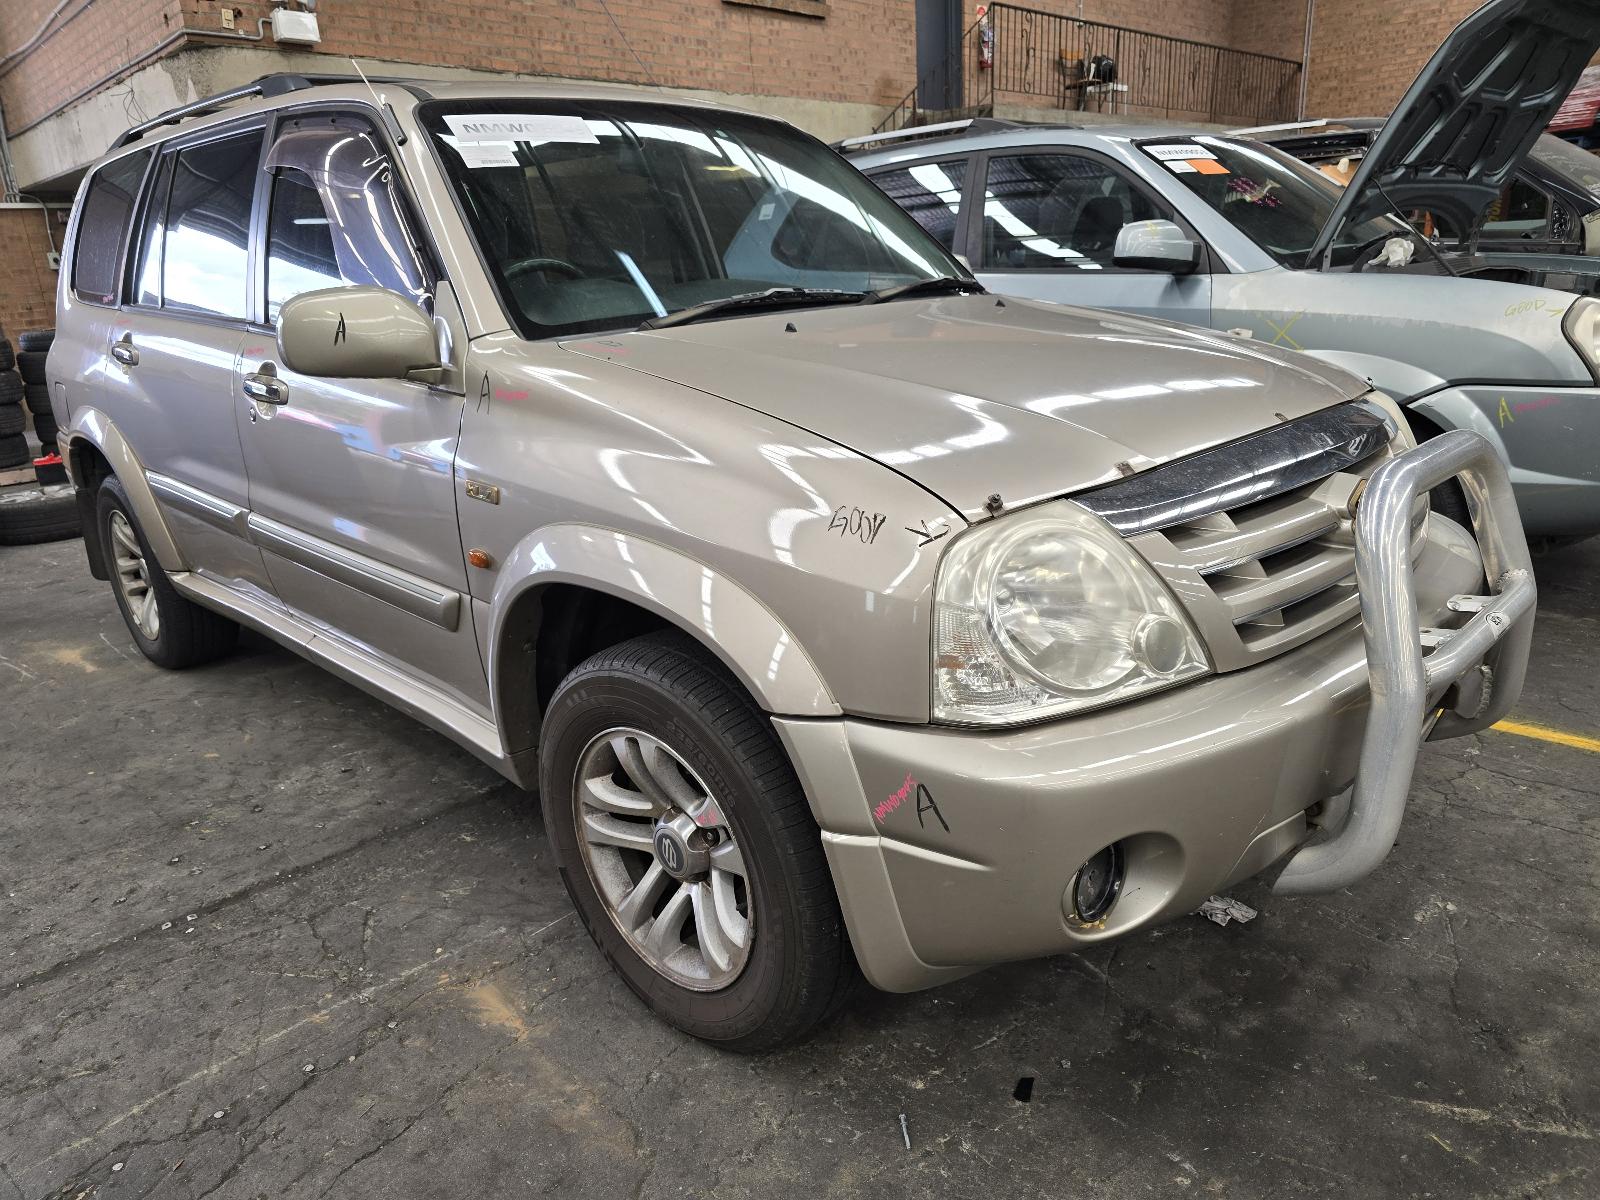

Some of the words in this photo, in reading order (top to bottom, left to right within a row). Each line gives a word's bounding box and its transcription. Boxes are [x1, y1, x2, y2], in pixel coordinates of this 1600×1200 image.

[1504, 299, 1546, 317] GOOD
[334, 312, 346, 346] A
[477, 370, 491, 415] A
[1499, 396, 1515, 429] A
[916, 783, 951, 834] A
